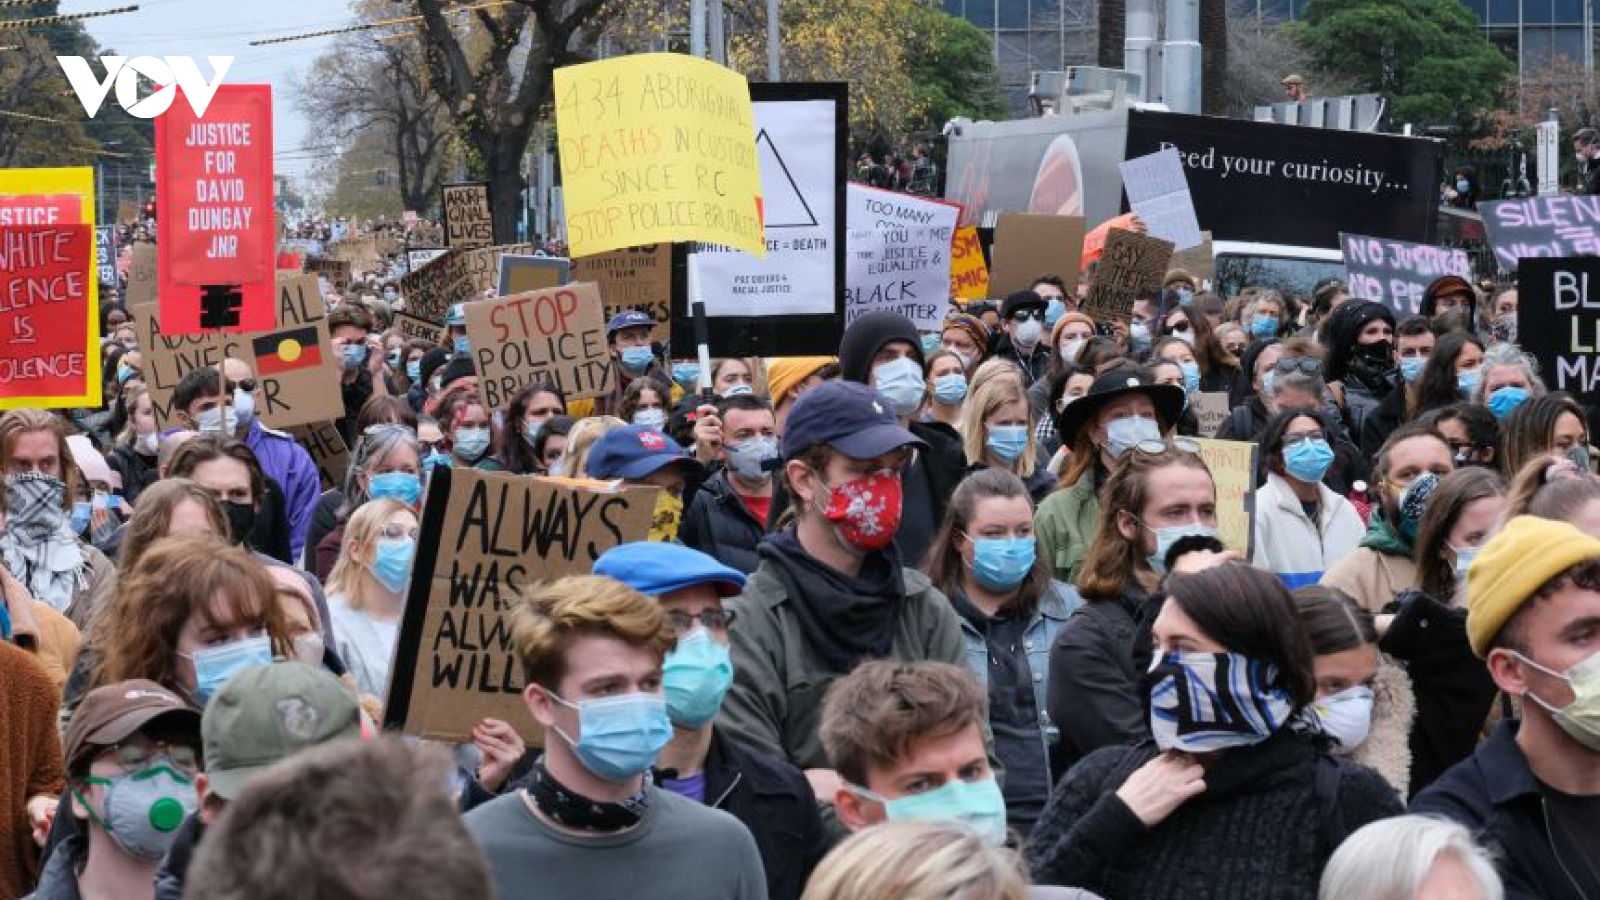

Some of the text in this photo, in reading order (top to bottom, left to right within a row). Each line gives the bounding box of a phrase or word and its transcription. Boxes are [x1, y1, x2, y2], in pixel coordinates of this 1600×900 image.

[560, 75, 625, 126] 434
[186, 123, 252, 147] JUSTICE
[205, 151, 236, 174] FOR
[561, 126, 665, 176] DEATHS
[1221, 154, 1276, 178] your
[196, 179, 245, 202] DAVID
[601, 162, 680, 202] SINCE
[188, 207, 252, 230] DUNGAY
[865, 199, 893, 216] TOO
[896, 206, 935, 224] MANY
[450, 223, 492, 239] LIVES
[567, 206, 624, 248] STOP
[628, 202, 699, 231] POLICE
[882, 229, 909, 244] YOU
[930, 227, 951, 241] ME
[207, 236, 239, 258] JNR
[793, 238, 827, 251] DEATH
[882, 246, 927, 261] JUSTICE
[1348, 237, 1384, 266] NO
[868, 259, 929, 275] EQUALITY
[760, 284, 791, 294] JUSTICE
[845, 280, 917, 304] BLACK
[1348, 273, 1383, 303] NO
[14, 315, 34, 340] IS
[489, 289, 578, 343] STOP
[478, 329, 605, 377] POLICE
[484, 360, 611, 409] BRTALITY
[456, 479, 630, 561] ALWAYS
[449, 558, 527, 612] WAS
[433, 610, 516, 652] ALW
[432, 653, 525, 695] WILL
